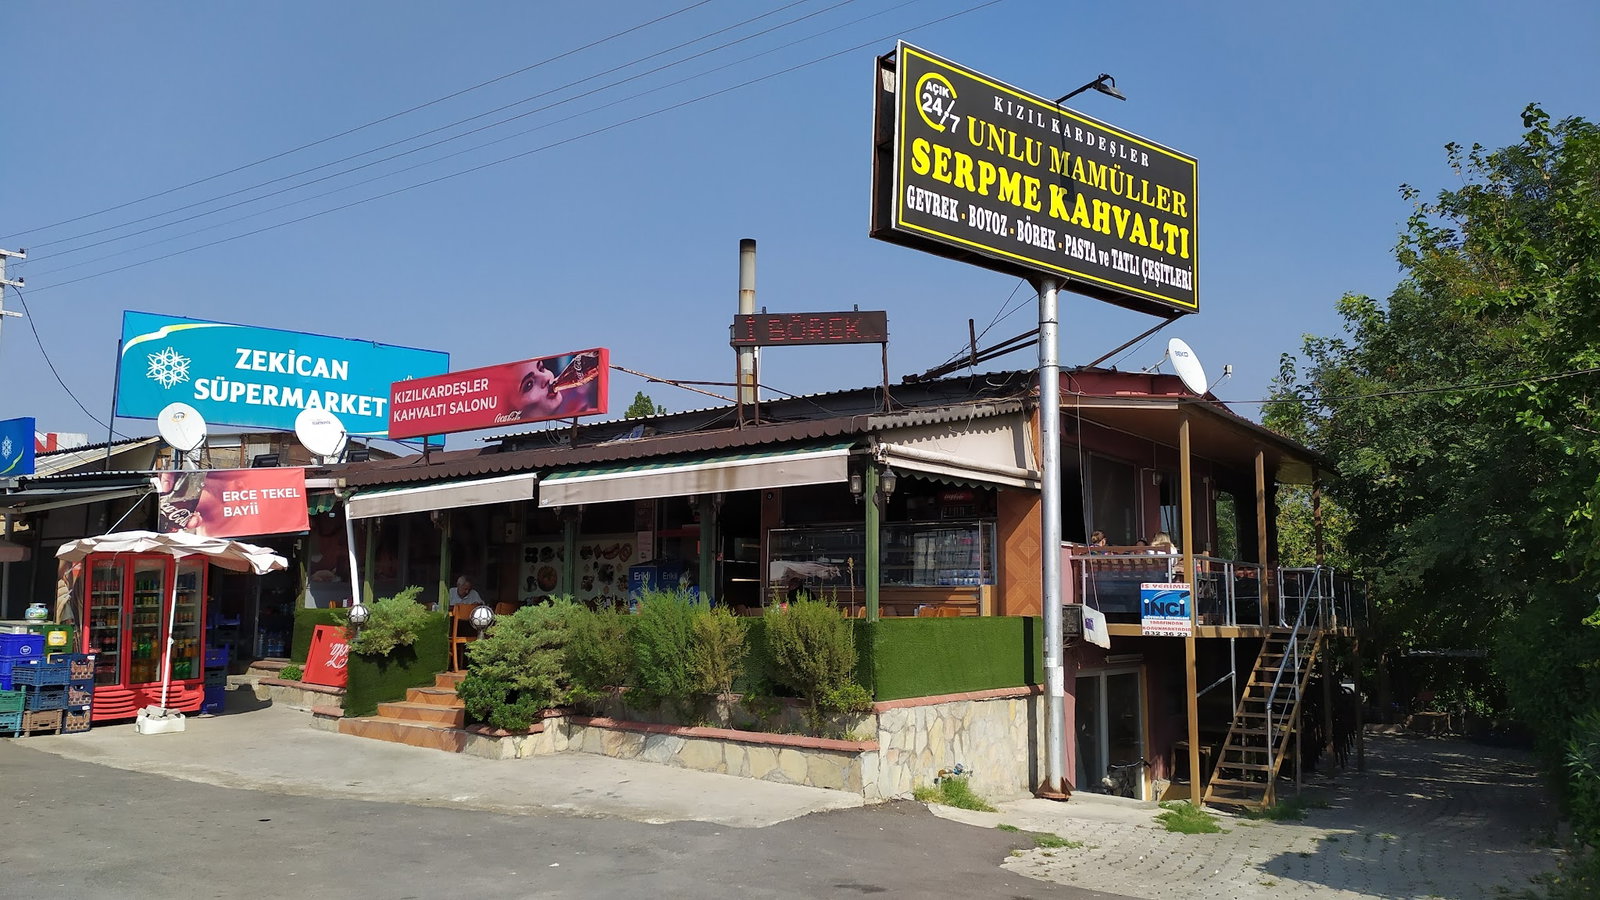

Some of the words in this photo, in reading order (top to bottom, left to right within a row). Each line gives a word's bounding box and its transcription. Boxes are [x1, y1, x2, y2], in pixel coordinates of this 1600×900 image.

[925, 81, 950, 98] AÇIK
[922, 92, 961, 133] 24/7
[994, 95, 1045, 128] KIZIL
[1051, 117, 1149, 167] KARDEŞLER
[967, 115, 1042, 167] UNLU
[1049, 145, 1187, 217] MAMÜLLER
[911, 137, 1042, 213] SERPME
[1049, 184, 1190, 259] KAHVALTI
[906, 184, 959, 222] GEVREK
[968, 204, 1008, 237] BOYOZ
[1017, 215, 1056, 251] BÖREK
[1064, 233, 1097, 264] PASTA
[1098, 250, 1110, 267] ve
[1111, 248, 1140, 276] TATLI
[1141, 256, 1193, 291] ÇEŞİTLERİ
[769, 315, 862, 341] BÖREK
[235, 347, 349, 381] ZEKİCAN
[193, 376, 387, 418] SÜPERMARKET
[394, 378, 489, 404] KIZILKARDEŞLER
[393, 404, 447, 422] KAHVALTI
[449, 396, 498, 415] SALONU
[222, 490, 257, 502] ERCE
[261, 487, 300, 499] TEKEL
[223, 504, 259, 517] BAYİİ
